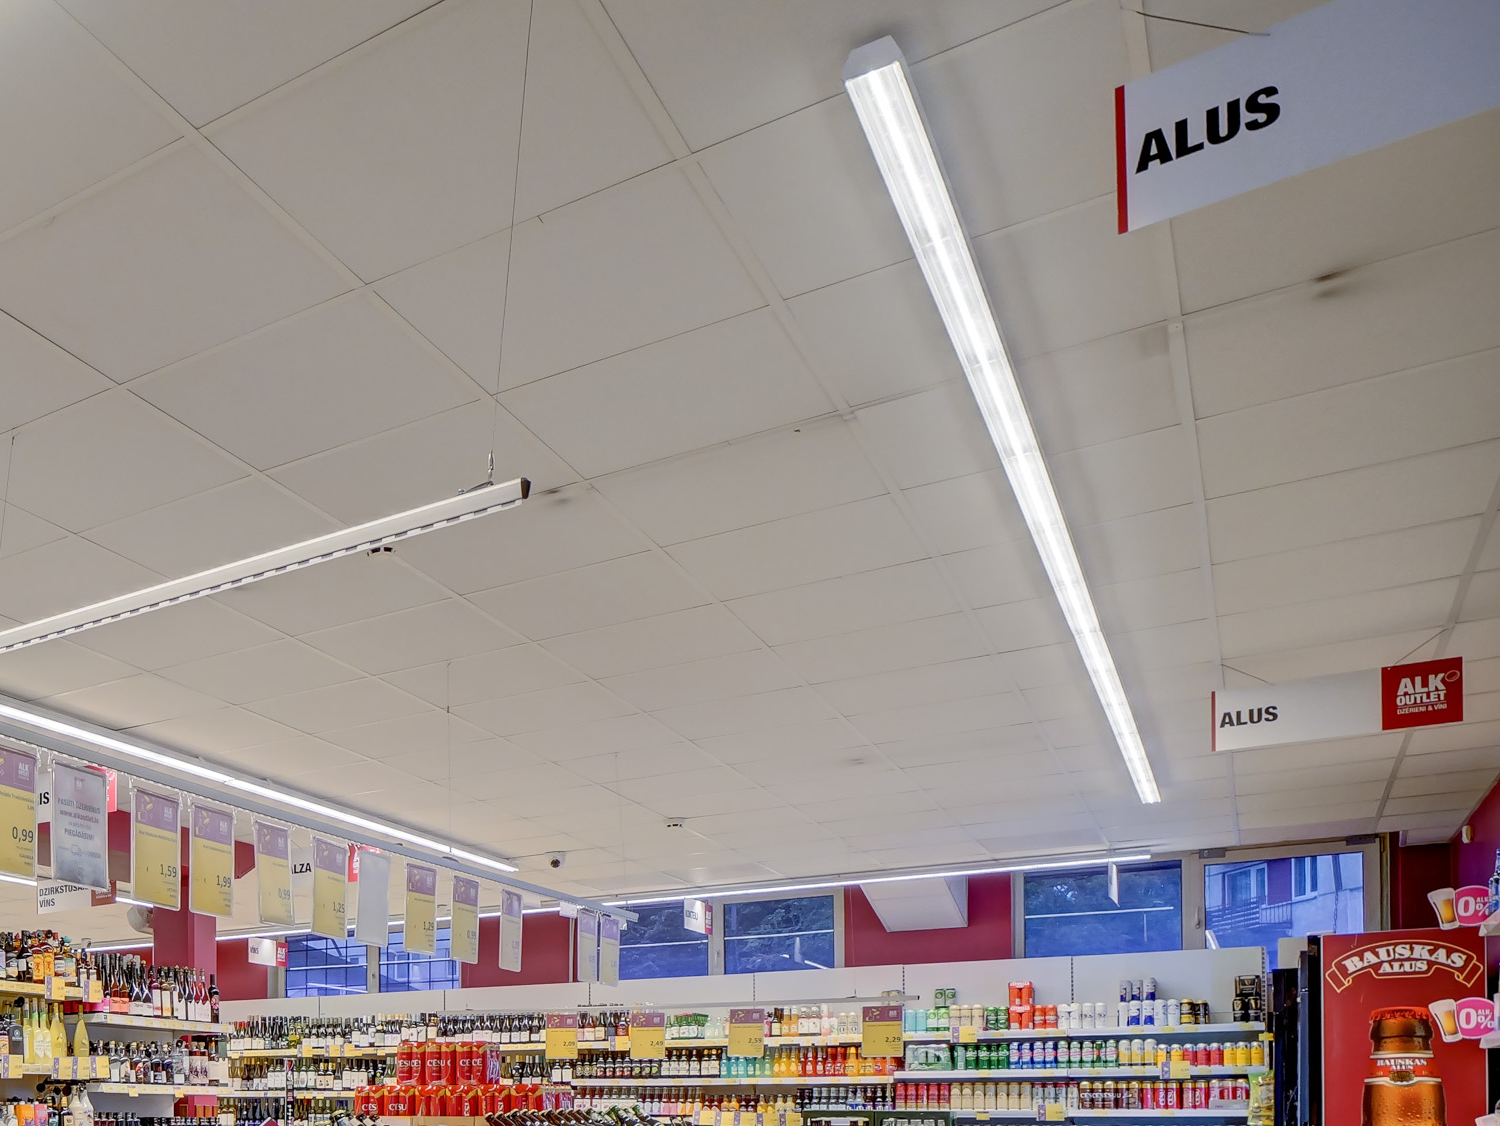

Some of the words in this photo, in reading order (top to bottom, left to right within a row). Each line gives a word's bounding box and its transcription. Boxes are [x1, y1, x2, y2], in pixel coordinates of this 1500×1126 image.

[1135, 85, 1281, 174] ALUS
[1396, 691, 1446, 706] OUTLET
[1219, 705, 1279, 728] ALUS
[12, 826, 34, 843] 0,99
[160, 864, 177, 878] 1,59
[216, 874, 232, 888] 1,99
[278, 888, 290, 899] 0,99
[39, 897, 55, 908] VĪNS
[333, 901, 345, 913] 1,25
[1342, 944, 1467, 974] BAUSKAS
[1378, 960, 1428, 974] ALUS
[1377, 1058, 1427, 1066] BAUSKAS
